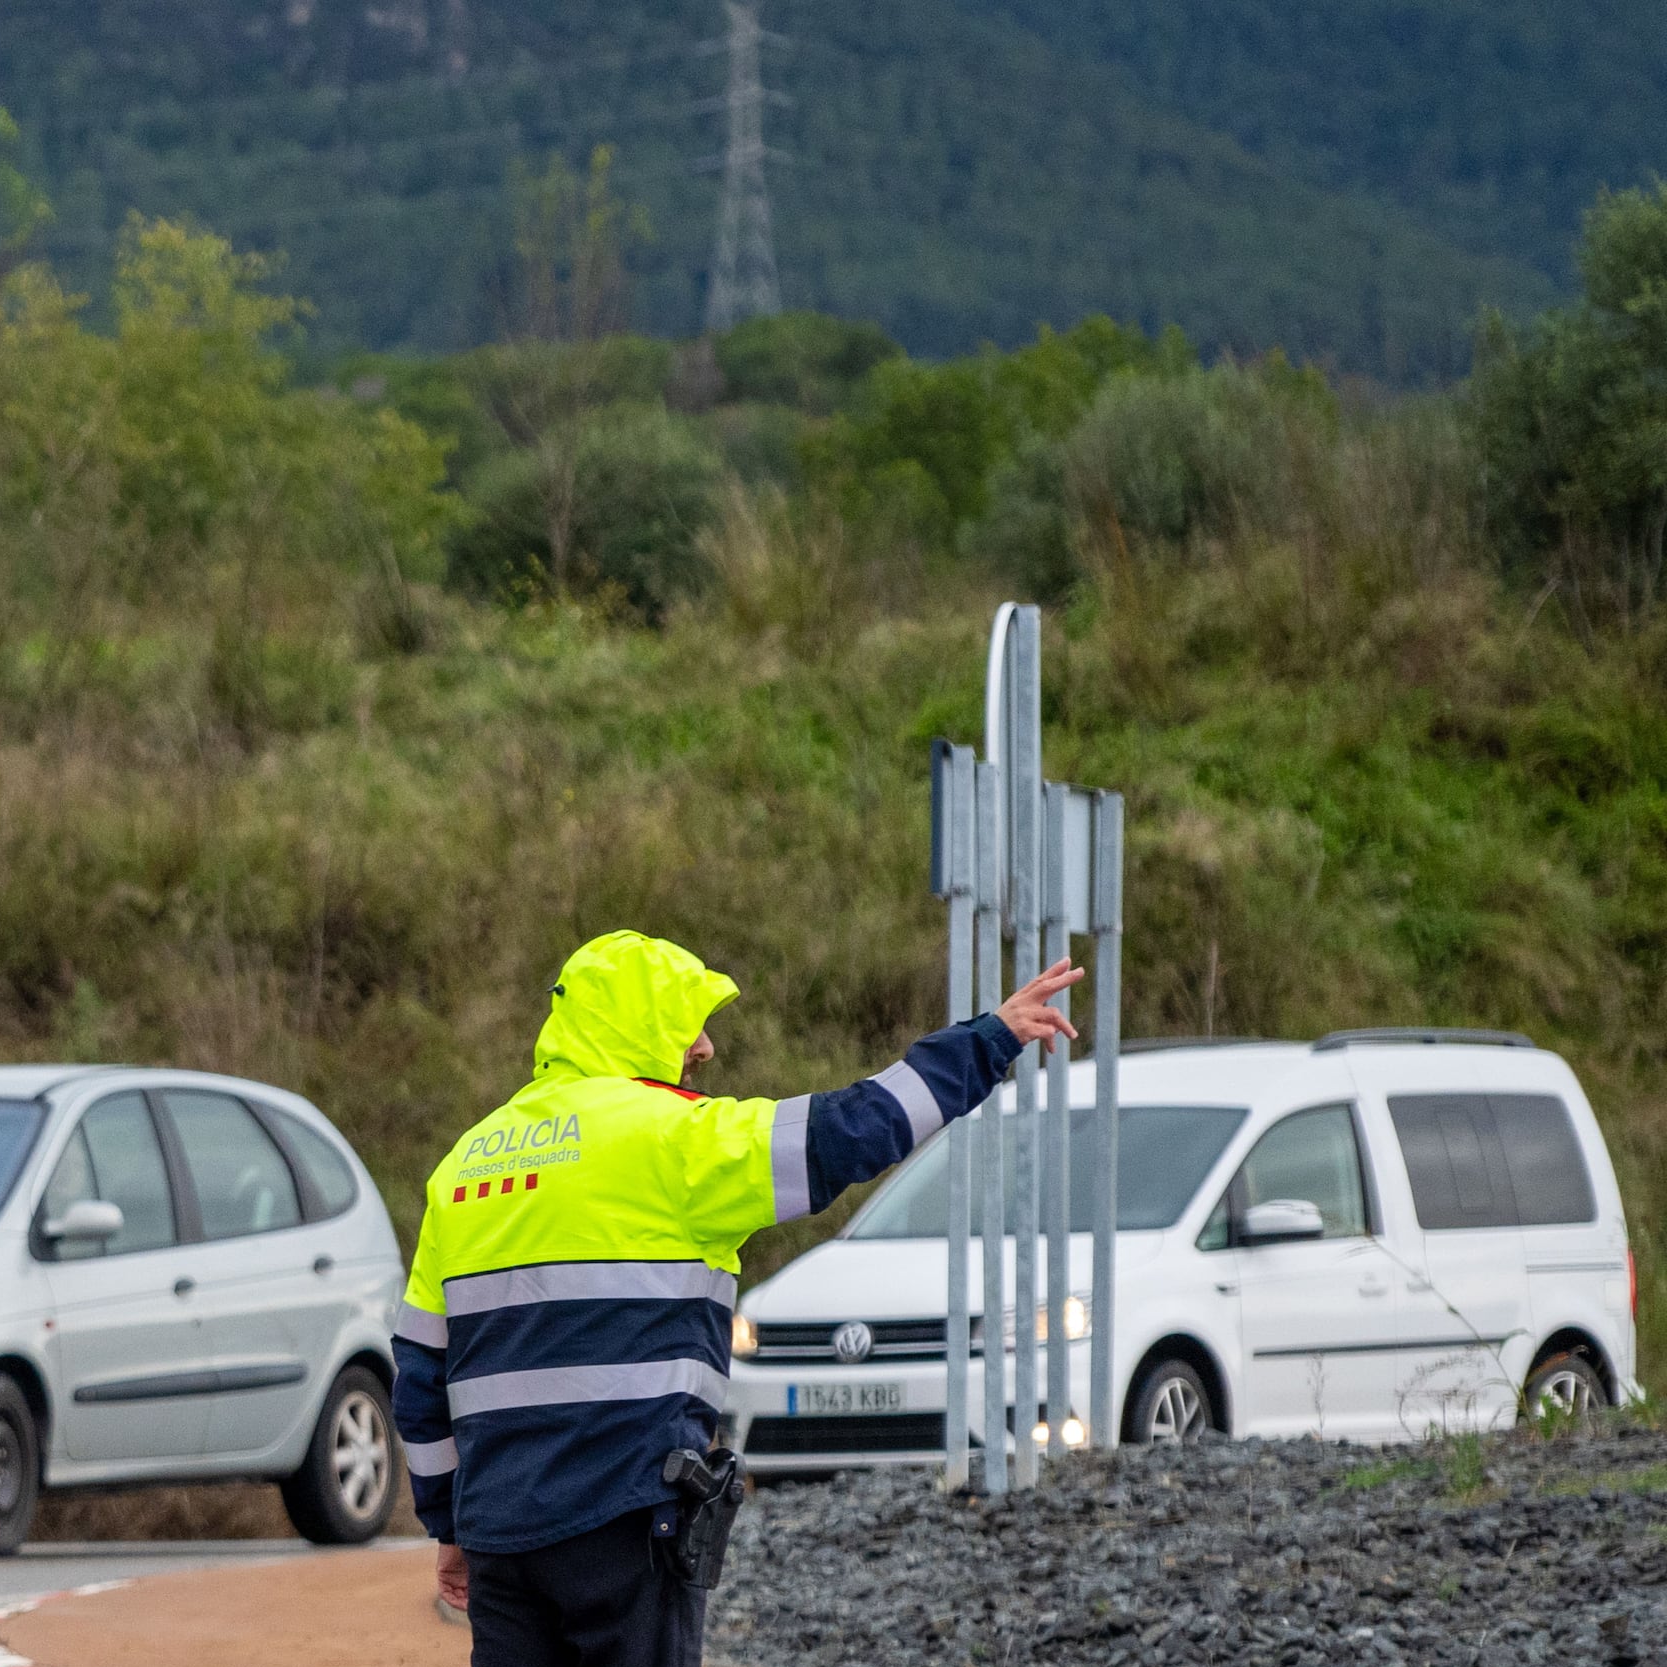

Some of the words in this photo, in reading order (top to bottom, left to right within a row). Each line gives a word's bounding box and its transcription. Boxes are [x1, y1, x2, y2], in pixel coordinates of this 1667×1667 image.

[463, 1114, 582, 1163] POLICIA
[457, 1161, 504, 1181] mossos
[507, 1147, 581, 1171] d'esquadra
